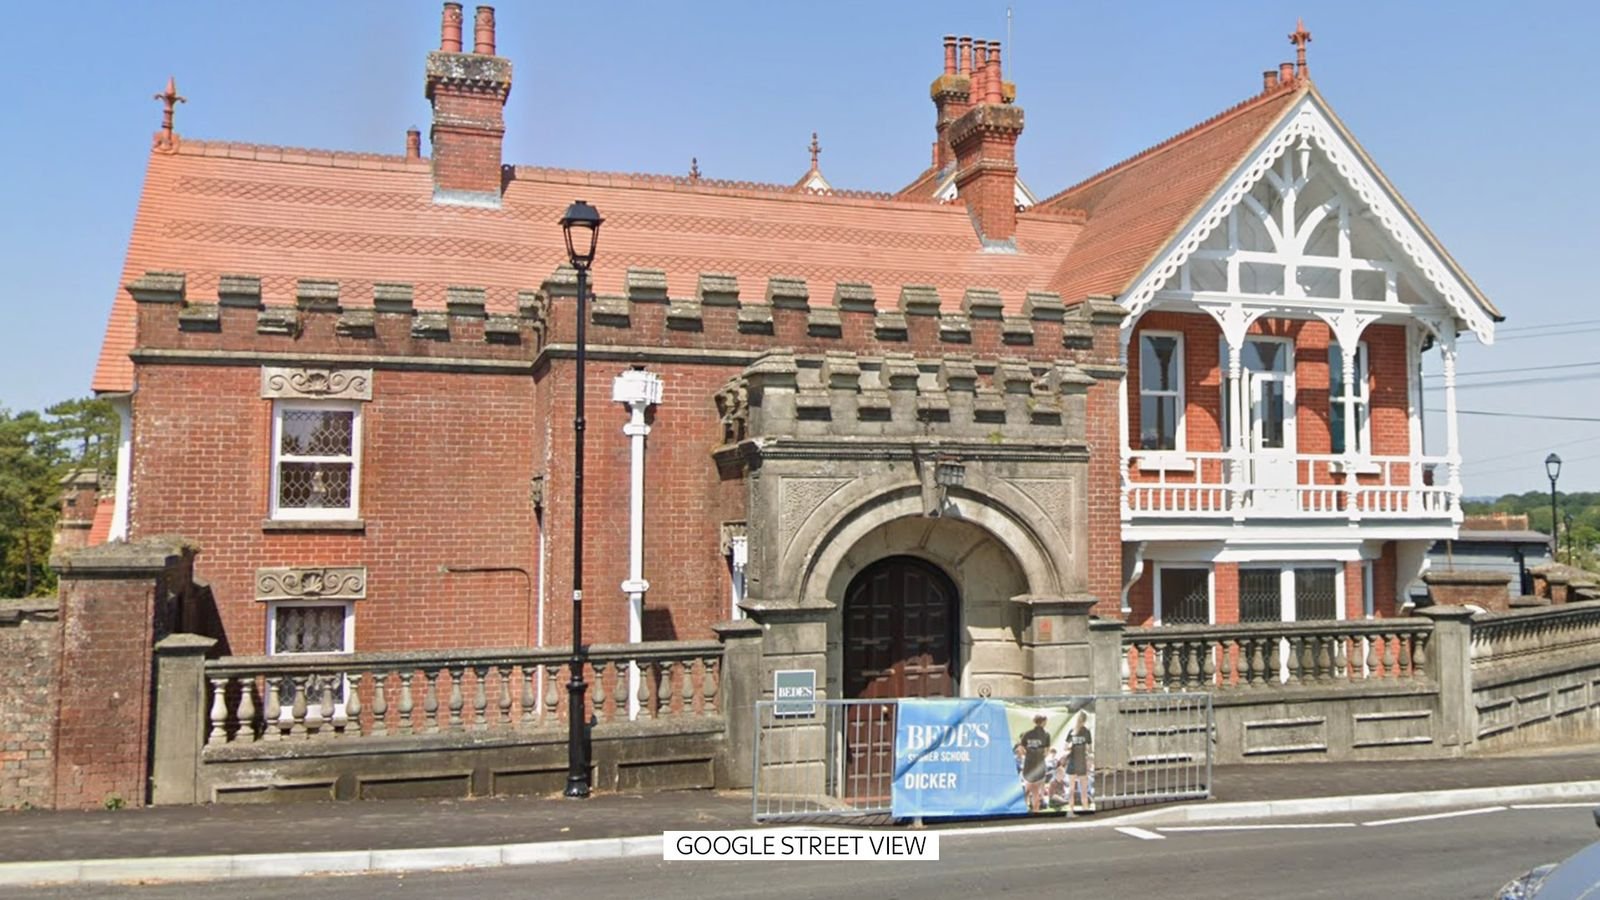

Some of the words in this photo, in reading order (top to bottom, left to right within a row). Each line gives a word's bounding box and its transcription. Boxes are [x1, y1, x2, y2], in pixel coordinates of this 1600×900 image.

[907, 722, 990, 750] BEDE'S
[940, 751, 971, 762] SCHOOL
[904, 772, 958, 790] DICKER
